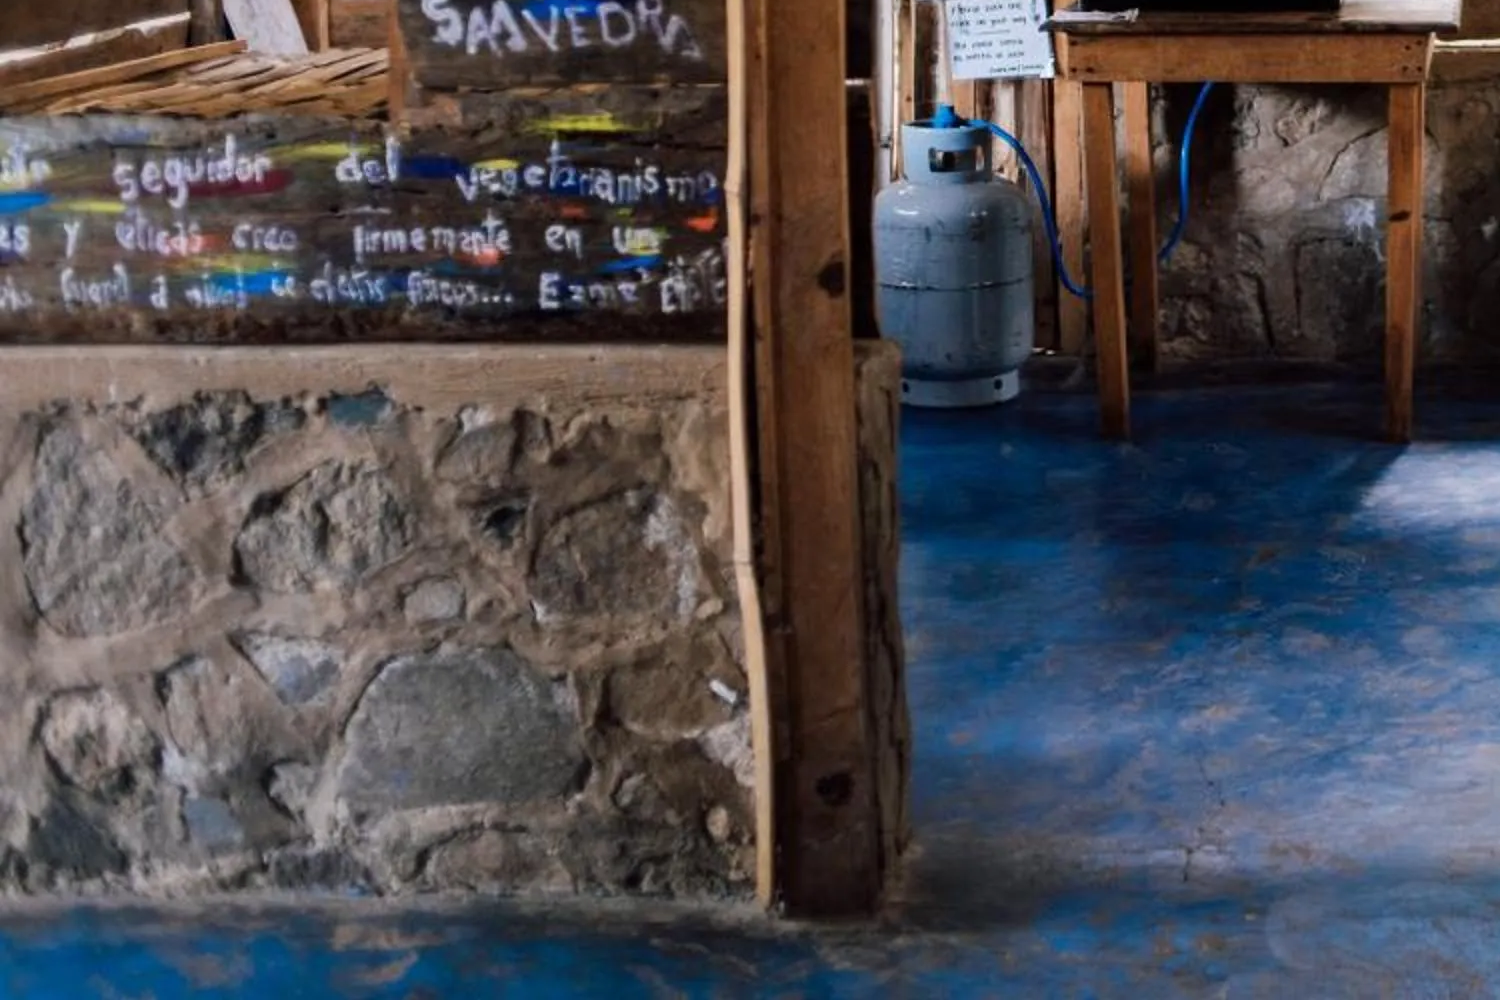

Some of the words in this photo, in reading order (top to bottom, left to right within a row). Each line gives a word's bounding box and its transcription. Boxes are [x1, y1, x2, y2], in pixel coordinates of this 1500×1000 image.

[113, 133, 273, 209] seguidor
[335, 133, 400, 184] del
[232, 222, 298, 251] creo
[545, 224, 584, 260] en
